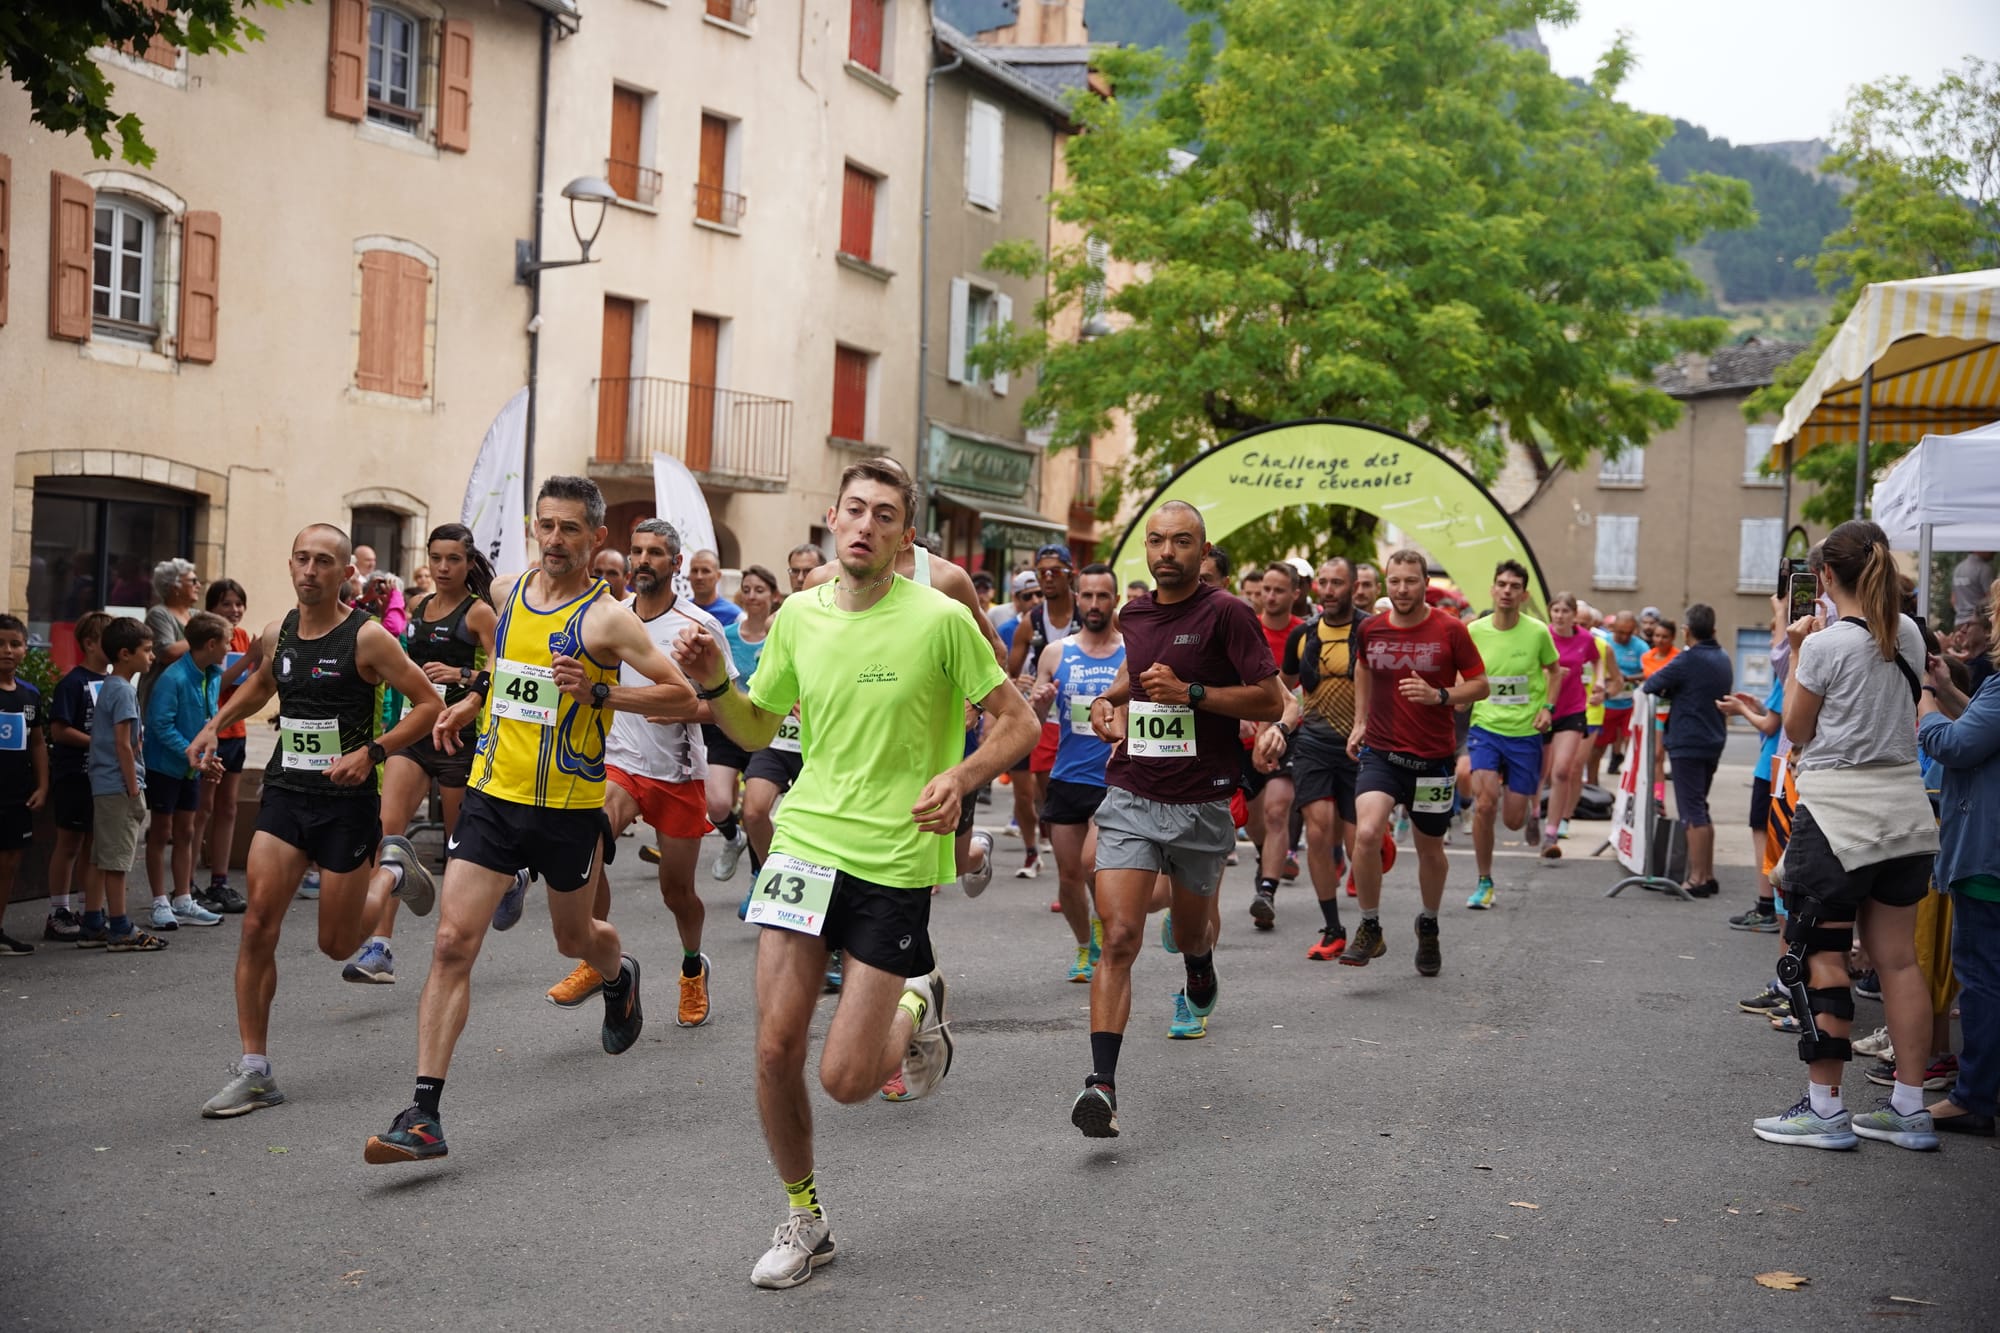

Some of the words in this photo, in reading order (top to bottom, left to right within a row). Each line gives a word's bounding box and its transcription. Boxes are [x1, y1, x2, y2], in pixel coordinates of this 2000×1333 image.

[1242, 452, 1350, 475] Challenge
[1364, 452, 1400, 468] des
[1229, 472, 1304, 489] vallées
[1318, 472, 1414, 489] cévenoles
[1366, 653, 1441, 671] TRAIL
[505, 677, 539, 704] 48
[1497, 683, 1516, 696] 21
[1135, 716, 1185, 739] 104
[293, 732, 322, 754] 55
[1429, 786, 1453, 802] 35
[763, 872, 806, 905] 43
